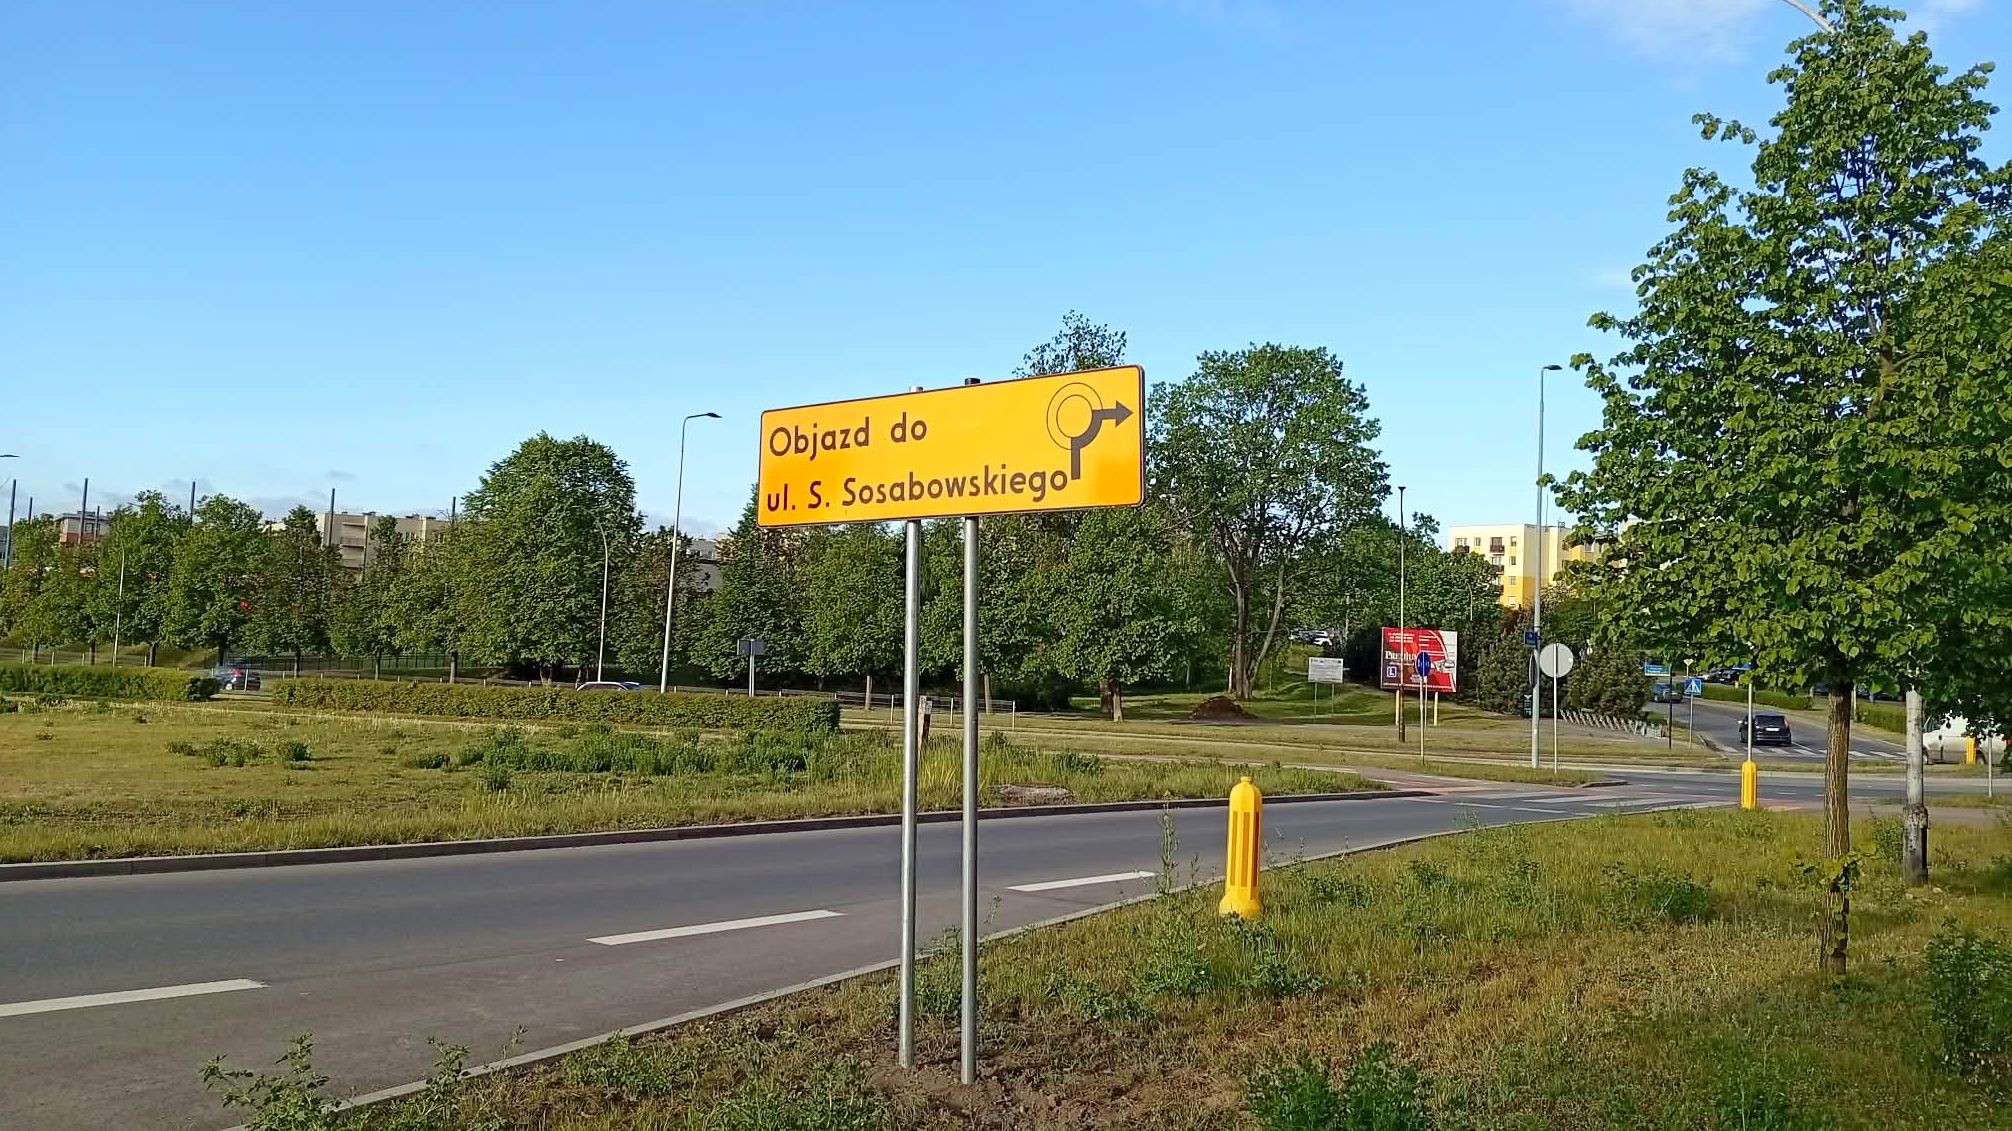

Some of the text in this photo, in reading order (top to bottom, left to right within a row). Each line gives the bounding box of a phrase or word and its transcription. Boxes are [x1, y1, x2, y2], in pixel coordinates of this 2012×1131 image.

[769, 411, 927, 462] Objazd do
[767, 463, 1068, 512] ul. S. Sosabowskiego
